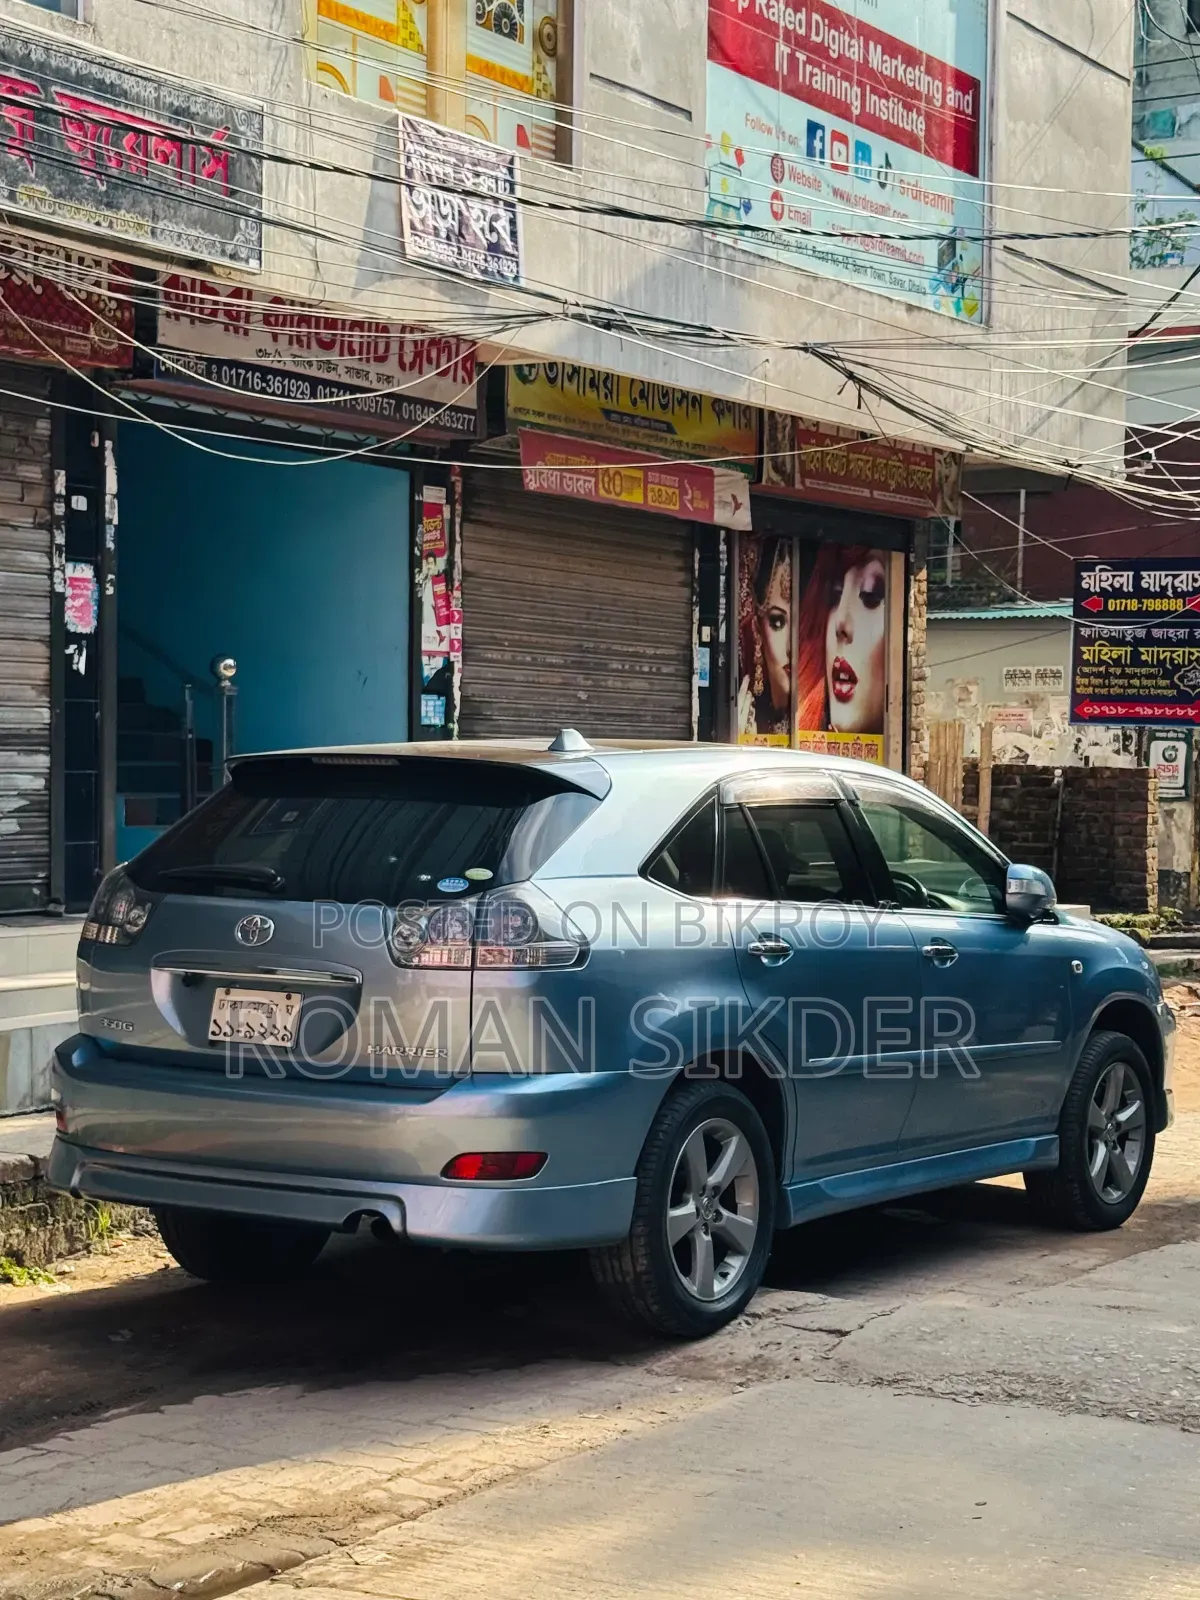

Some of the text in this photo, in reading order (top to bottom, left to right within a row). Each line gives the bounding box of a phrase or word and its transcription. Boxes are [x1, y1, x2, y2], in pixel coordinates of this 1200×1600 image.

[811, 13, 864, 64] Digital
[868, 41, 943, 107] Marketing
[946, 84, 973, 116] and
[774, 42, 926, 137] IT Training Institute
[745, 112, 773, 136] Follow
[788, 164, 822, 193] Website
[788, 205, 812, 227] Email
[402, 402, 476, 432] 01846-363277
[526, 461, 561, 490] সুবিধা
[562, 472, 596, 497] ডাবল
[1080, 564, 1135, 593] মহিলা
[1107, 598, 1184, 612] 01718-798888
[1080, 641, 1134, 666] মহিলা
[1083, 704, 1199, 716] ০১৭১৮-৭৯৮৮৮৮
[218, 999, 244, 1012] ঢাকা
[366, 1044, 449, 1060] HARRIER
